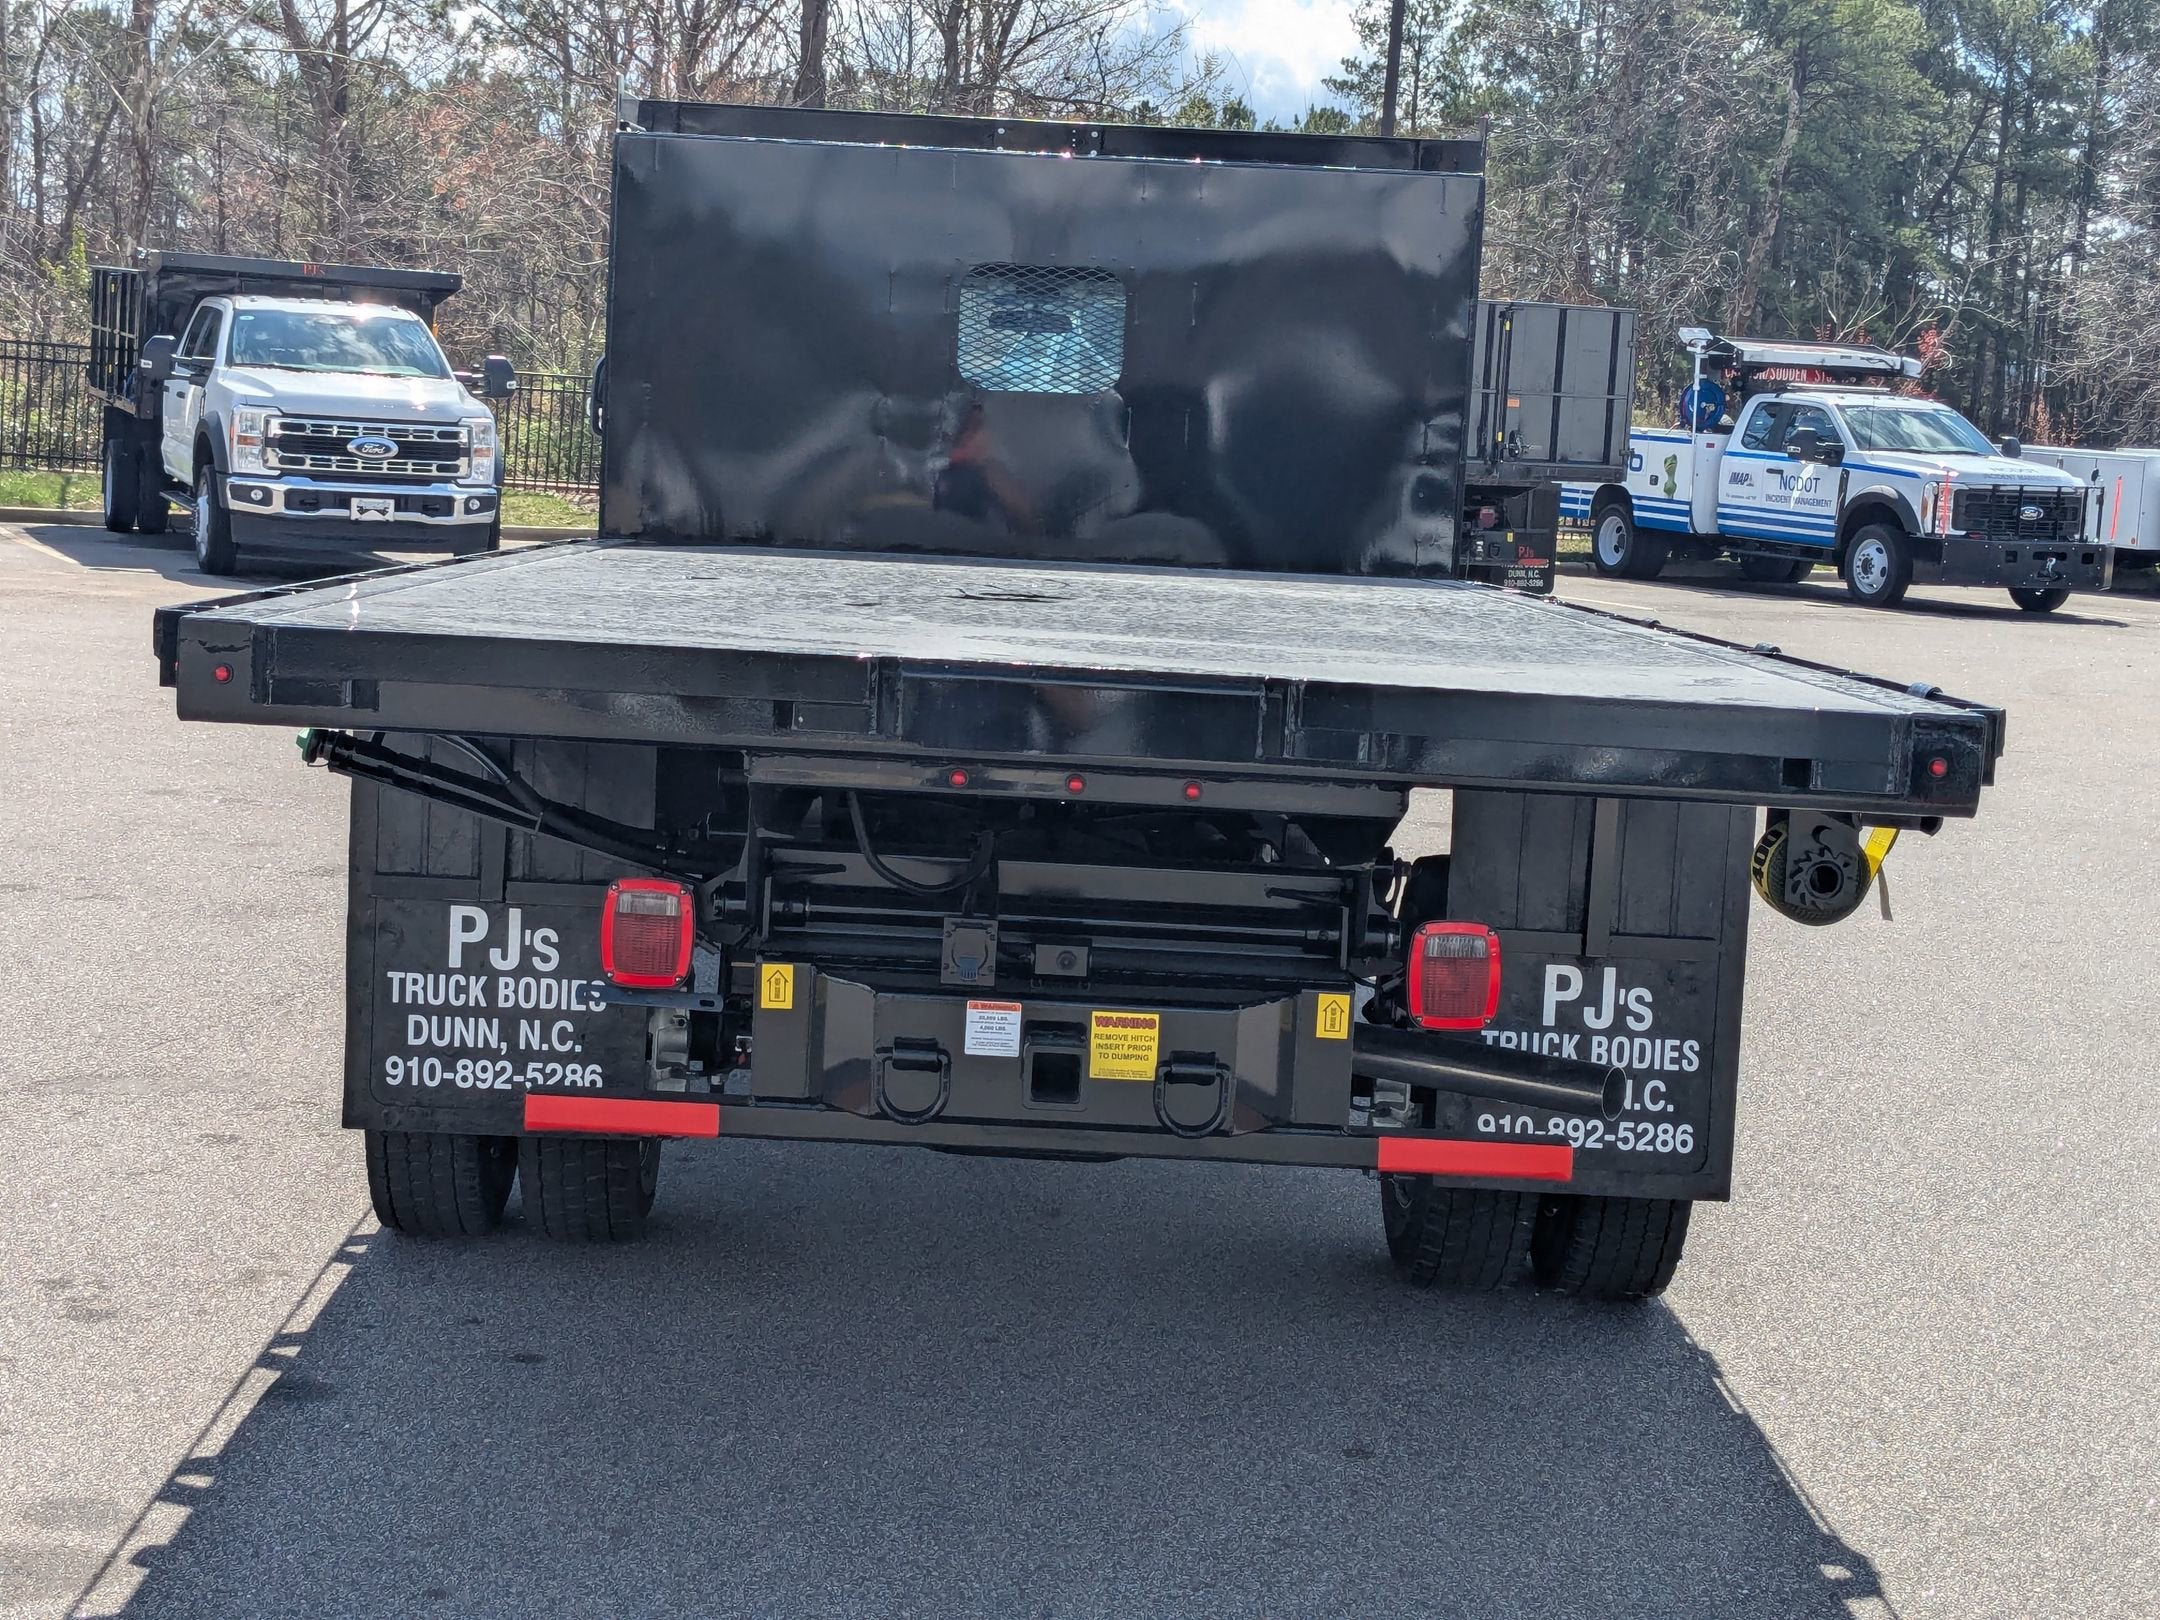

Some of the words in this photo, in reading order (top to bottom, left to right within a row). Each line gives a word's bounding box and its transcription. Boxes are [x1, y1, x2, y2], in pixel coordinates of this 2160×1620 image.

[1779, 475, 1821, 494] NCDOT
[387, 972, 488, 1007] TRUCK
[1095, 1016, 1157, 1030] WARNING
[407, 1014, 507, 1055] DUNN,
[519, 1020, 582, 1052] N.C.
[1094, 1033, 1129, 1041] REMOVE
[1130, 1034, 1156, 1043] HITCH
[1095, 1043, 1125, 1051] INSERT
[1127, 1043, 1153, 1052] PRIOR
[1098, 1052, 1109, 1060] TO
[1111, 1052, 1150, 1062] DUMPING
[1591, 1035, 1700, 1072] BODIES
[385, 1056, 603, 1090] 910-892-5286
